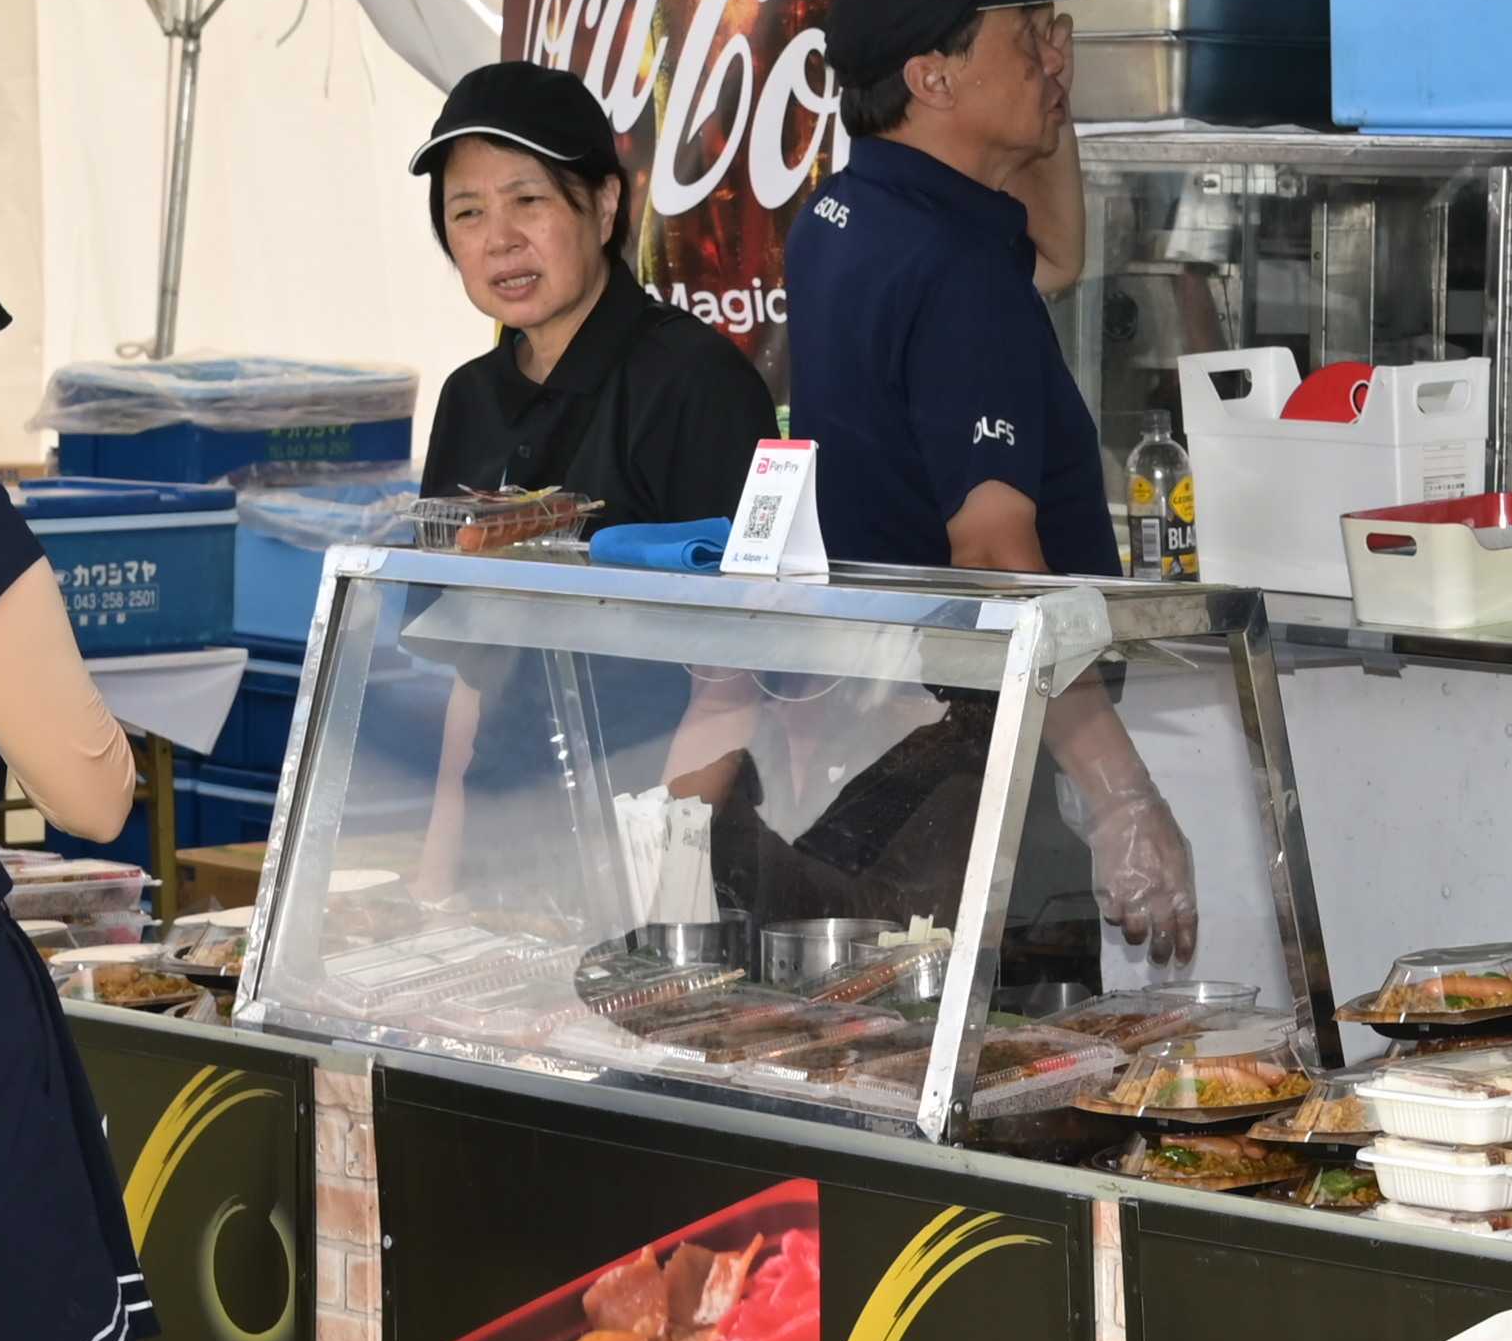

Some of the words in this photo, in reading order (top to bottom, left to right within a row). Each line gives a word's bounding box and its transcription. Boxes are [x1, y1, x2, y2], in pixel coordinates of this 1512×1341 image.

[813, 194, 851, 229] GOLF5
[646, 277, 788, 334] Magic
[73, 560, 157, 587] カワシマヤ
